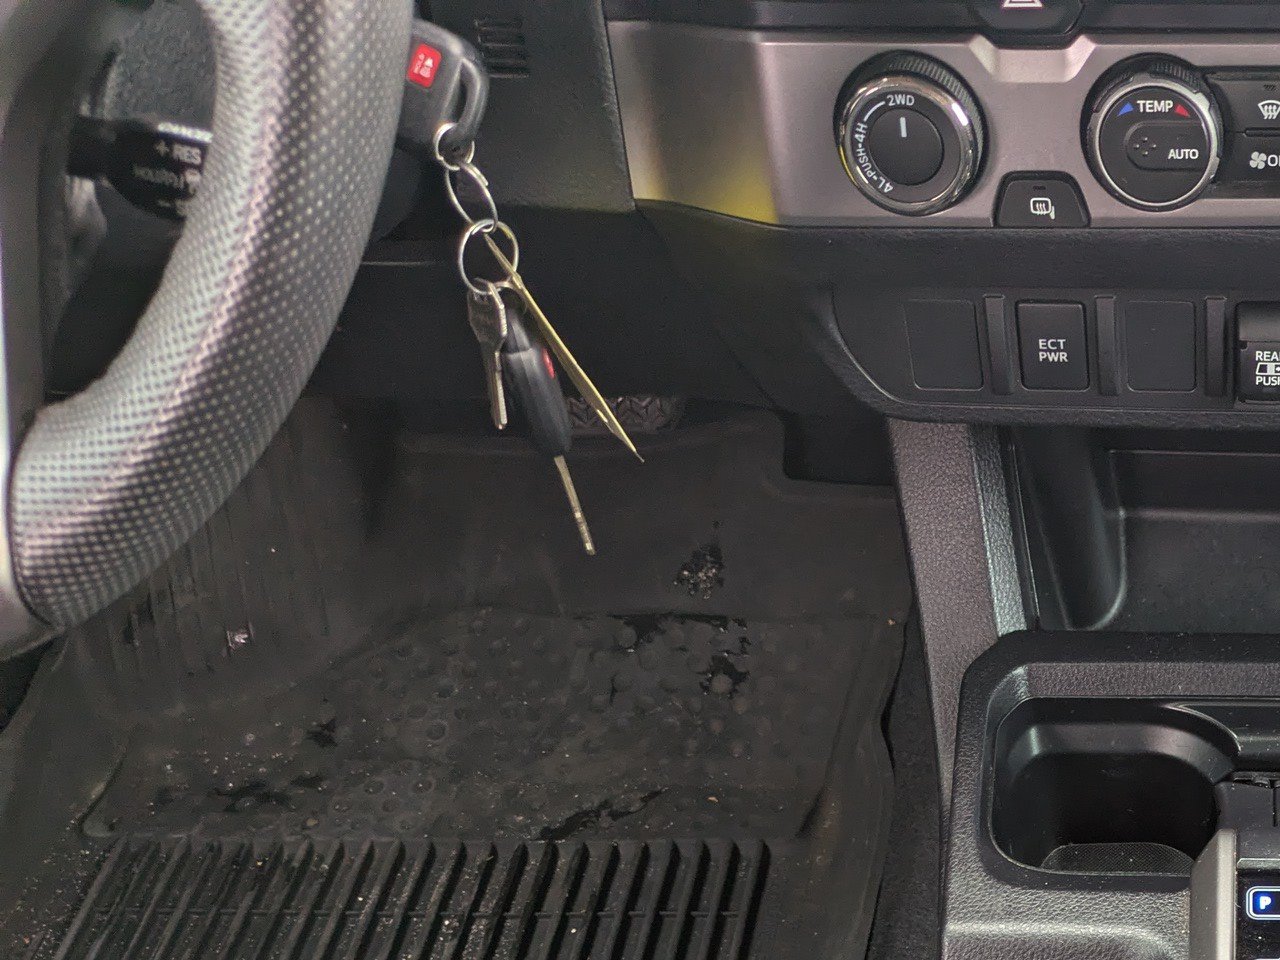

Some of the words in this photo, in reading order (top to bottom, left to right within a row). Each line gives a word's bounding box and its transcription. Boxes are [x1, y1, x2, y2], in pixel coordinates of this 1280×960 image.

[886, 94, 915, 106] 2WD
[1136, 100, 1174, 113] TEMP
[1167, 148, 1199, 160] AUTO
[1038, 338, 1067, 350] ECT
[1038, 351, 1068, 363] PWR
[1259, 896, 1272, 910] P
